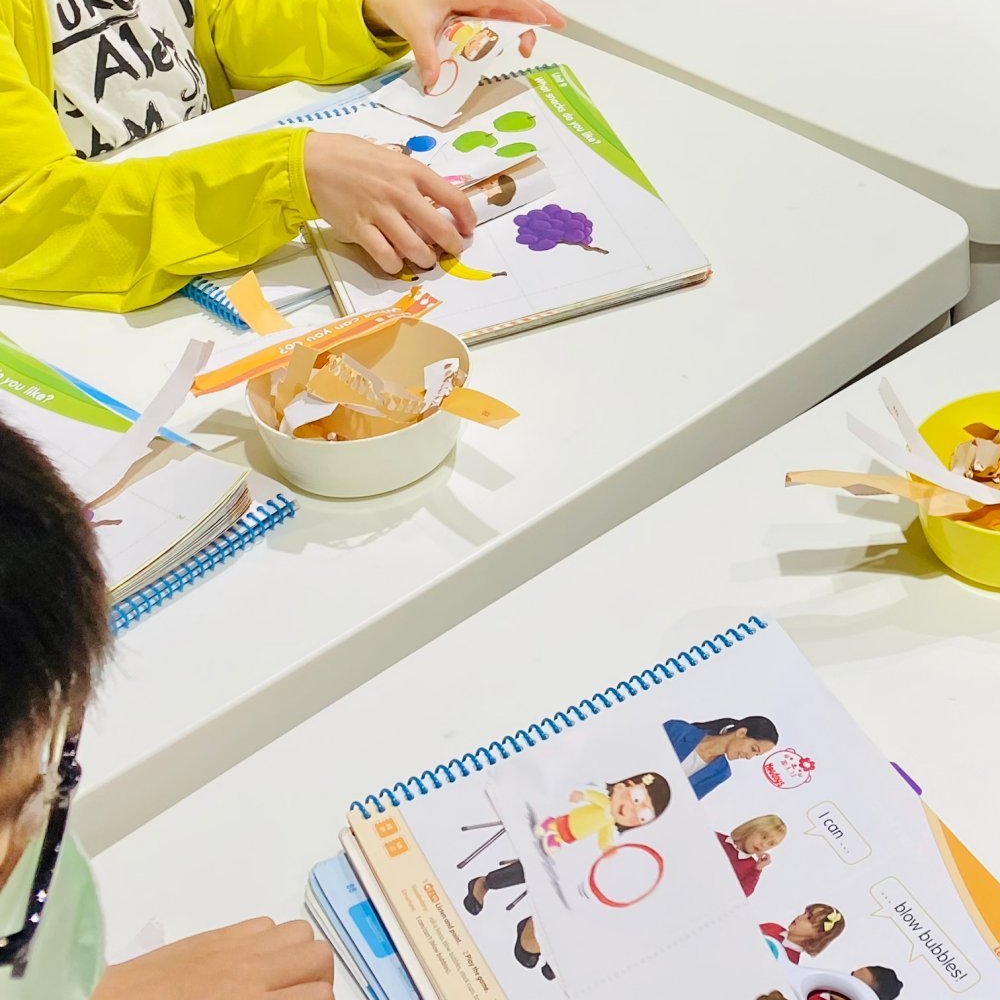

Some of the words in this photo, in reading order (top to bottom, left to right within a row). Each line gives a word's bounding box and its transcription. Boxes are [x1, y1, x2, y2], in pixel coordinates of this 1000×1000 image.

[534, 76, 551, 94] What
[545, 92, 566, 113] snacks
[562, 111, 573, 121] do
[568, 120, 584, 132] you
[582, 130, 601, 145] like?
[306, 325, 333, 344] you
[334, 317, 360, 331] can
[2, 377, 24, 391] you
[23, 386, 55, 403] like?
[818, 811, 830, 819] I
[823, 818, 844, 840] can
[434, 902, 447, 921] Listen
[444, 919, 454, 930] and
[894, 901, 923, 932] blow
[918, 929, 968, 982] bubbles!
[465, 954, 473, 967] Play
[471, 966, 480, 976] the
